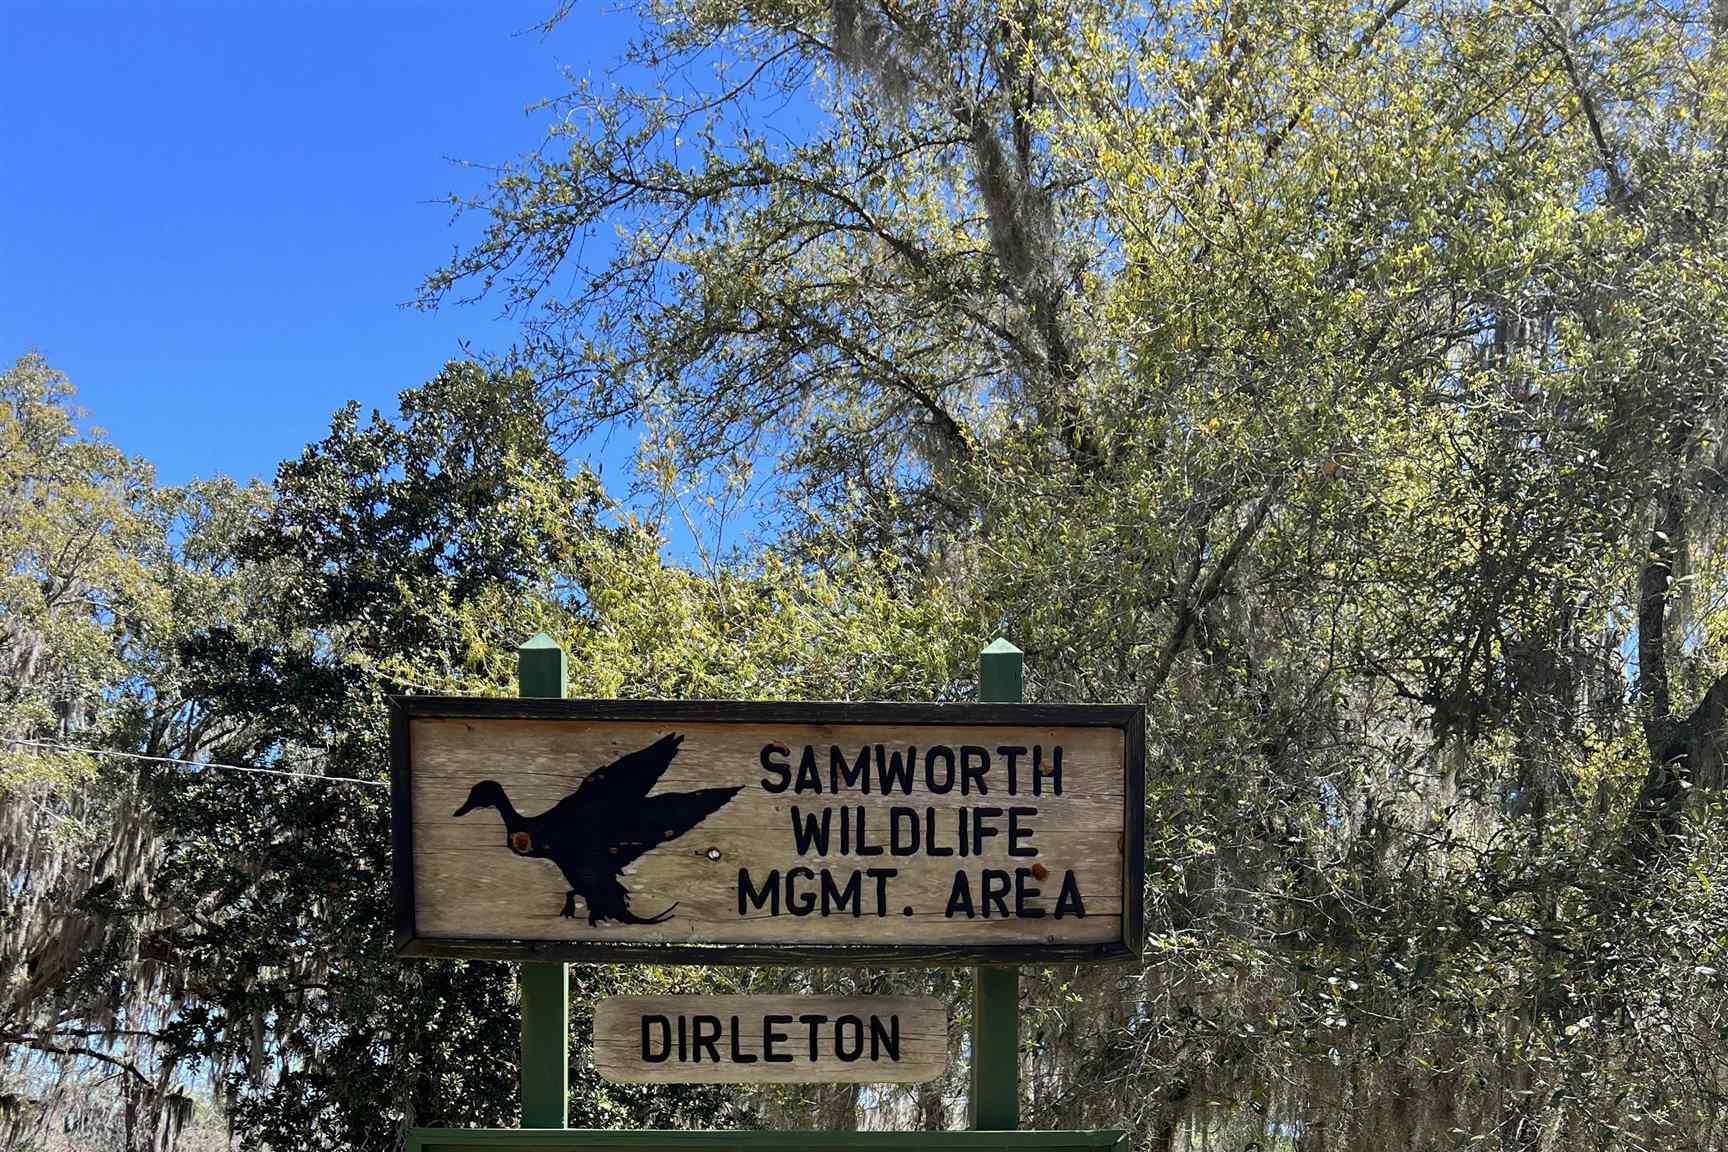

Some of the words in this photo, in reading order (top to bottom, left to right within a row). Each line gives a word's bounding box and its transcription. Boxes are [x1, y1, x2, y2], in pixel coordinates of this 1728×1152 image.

[760, 743, 1064, 797] SAMWORTH
[790, 805, 1039, 858] WILDLIFE
[737, 866, 914, 919] MGMT.
[944, 864, 1086, 921] AREA
[640, 1014, 901, 1064] DIRLETON
